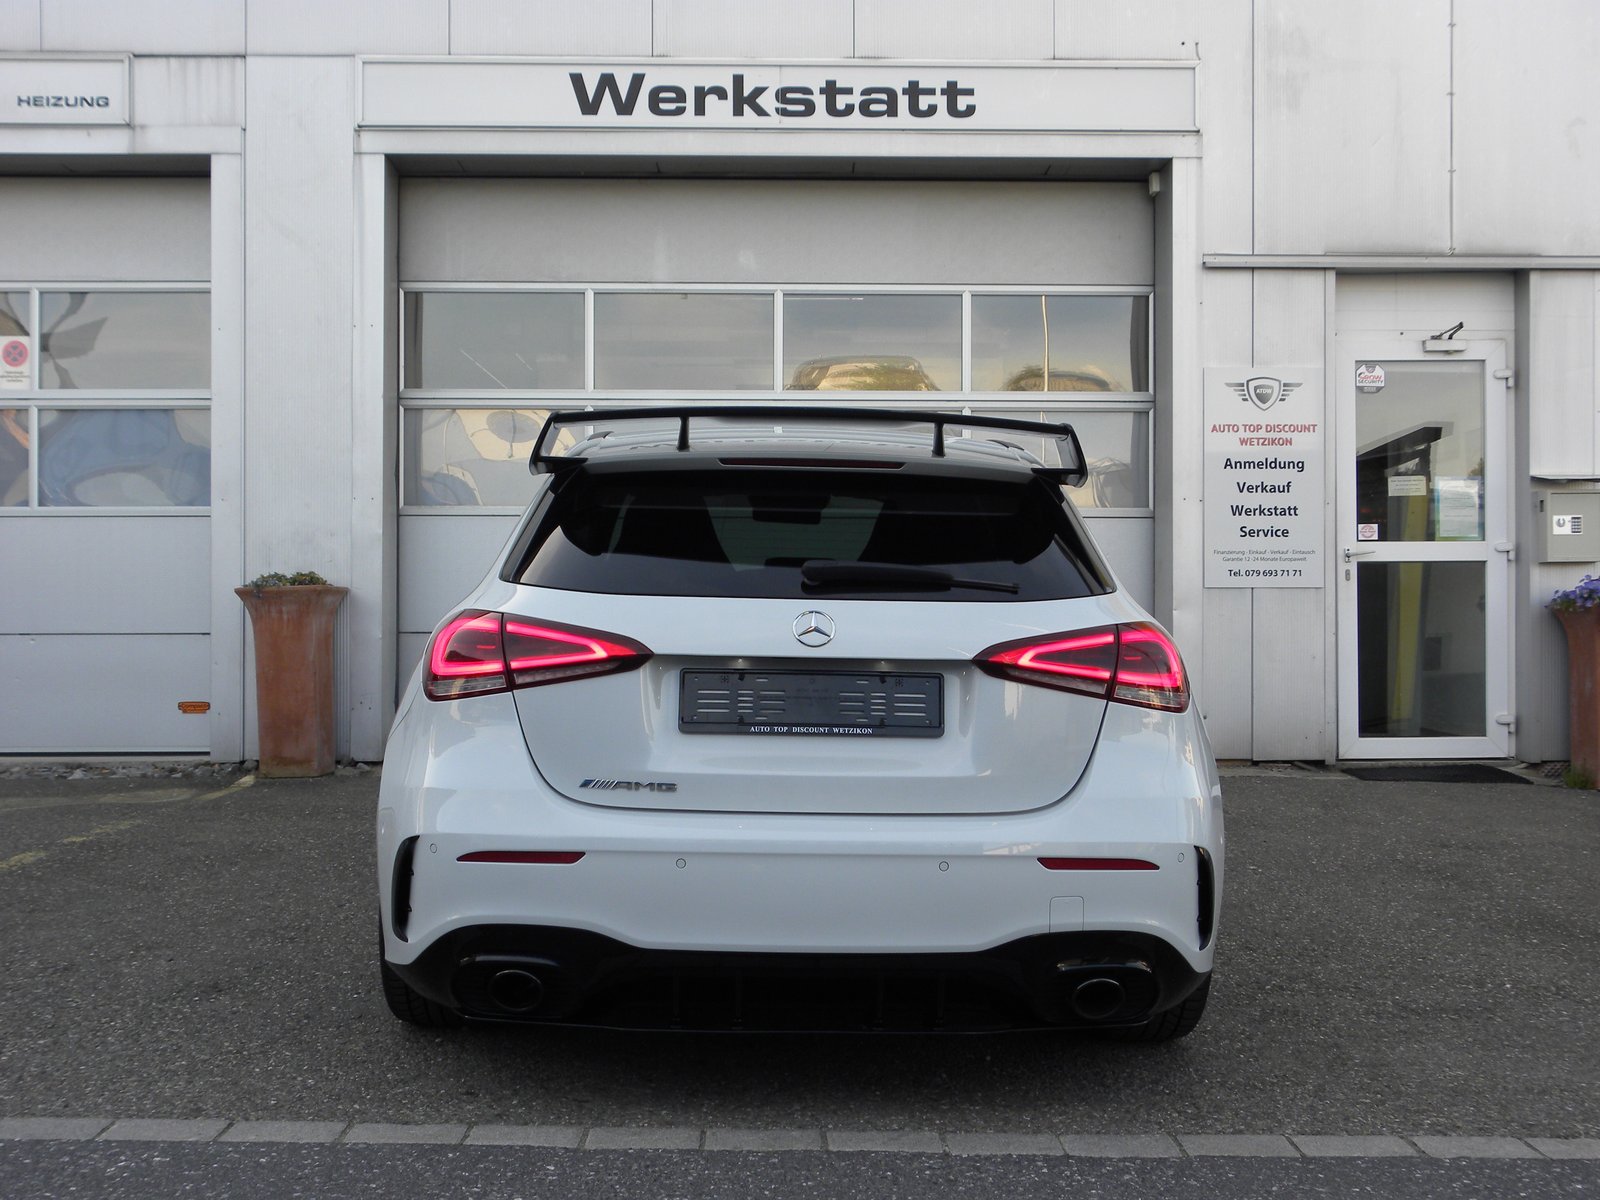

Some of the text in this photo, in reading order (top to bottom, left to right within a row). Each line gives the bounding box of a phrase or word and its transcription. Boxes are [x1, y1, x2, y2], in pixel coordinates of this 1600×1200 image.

[16, 95, 110, 107] HEIZUNG
[568, 72, 977, 119] Werkstatt
[1211, 424, 1318, 433] AUTO TOP DISCOUNT
[1238, 437, 1293, 446] WETZIKON
[1223, 457, 1305, 473] Anmeldung
[1236, 481, 1292, 494] Verkauf
[1230, 504, 1299, 516] Werkstatt
[1239, 525, 1290, 538] Service
[1228, 569, 1302, 577] Tel. 079 693 71 71
[792, 726, 829, 734] DISCOUNT
[611, 780, 677, 793] AMG
